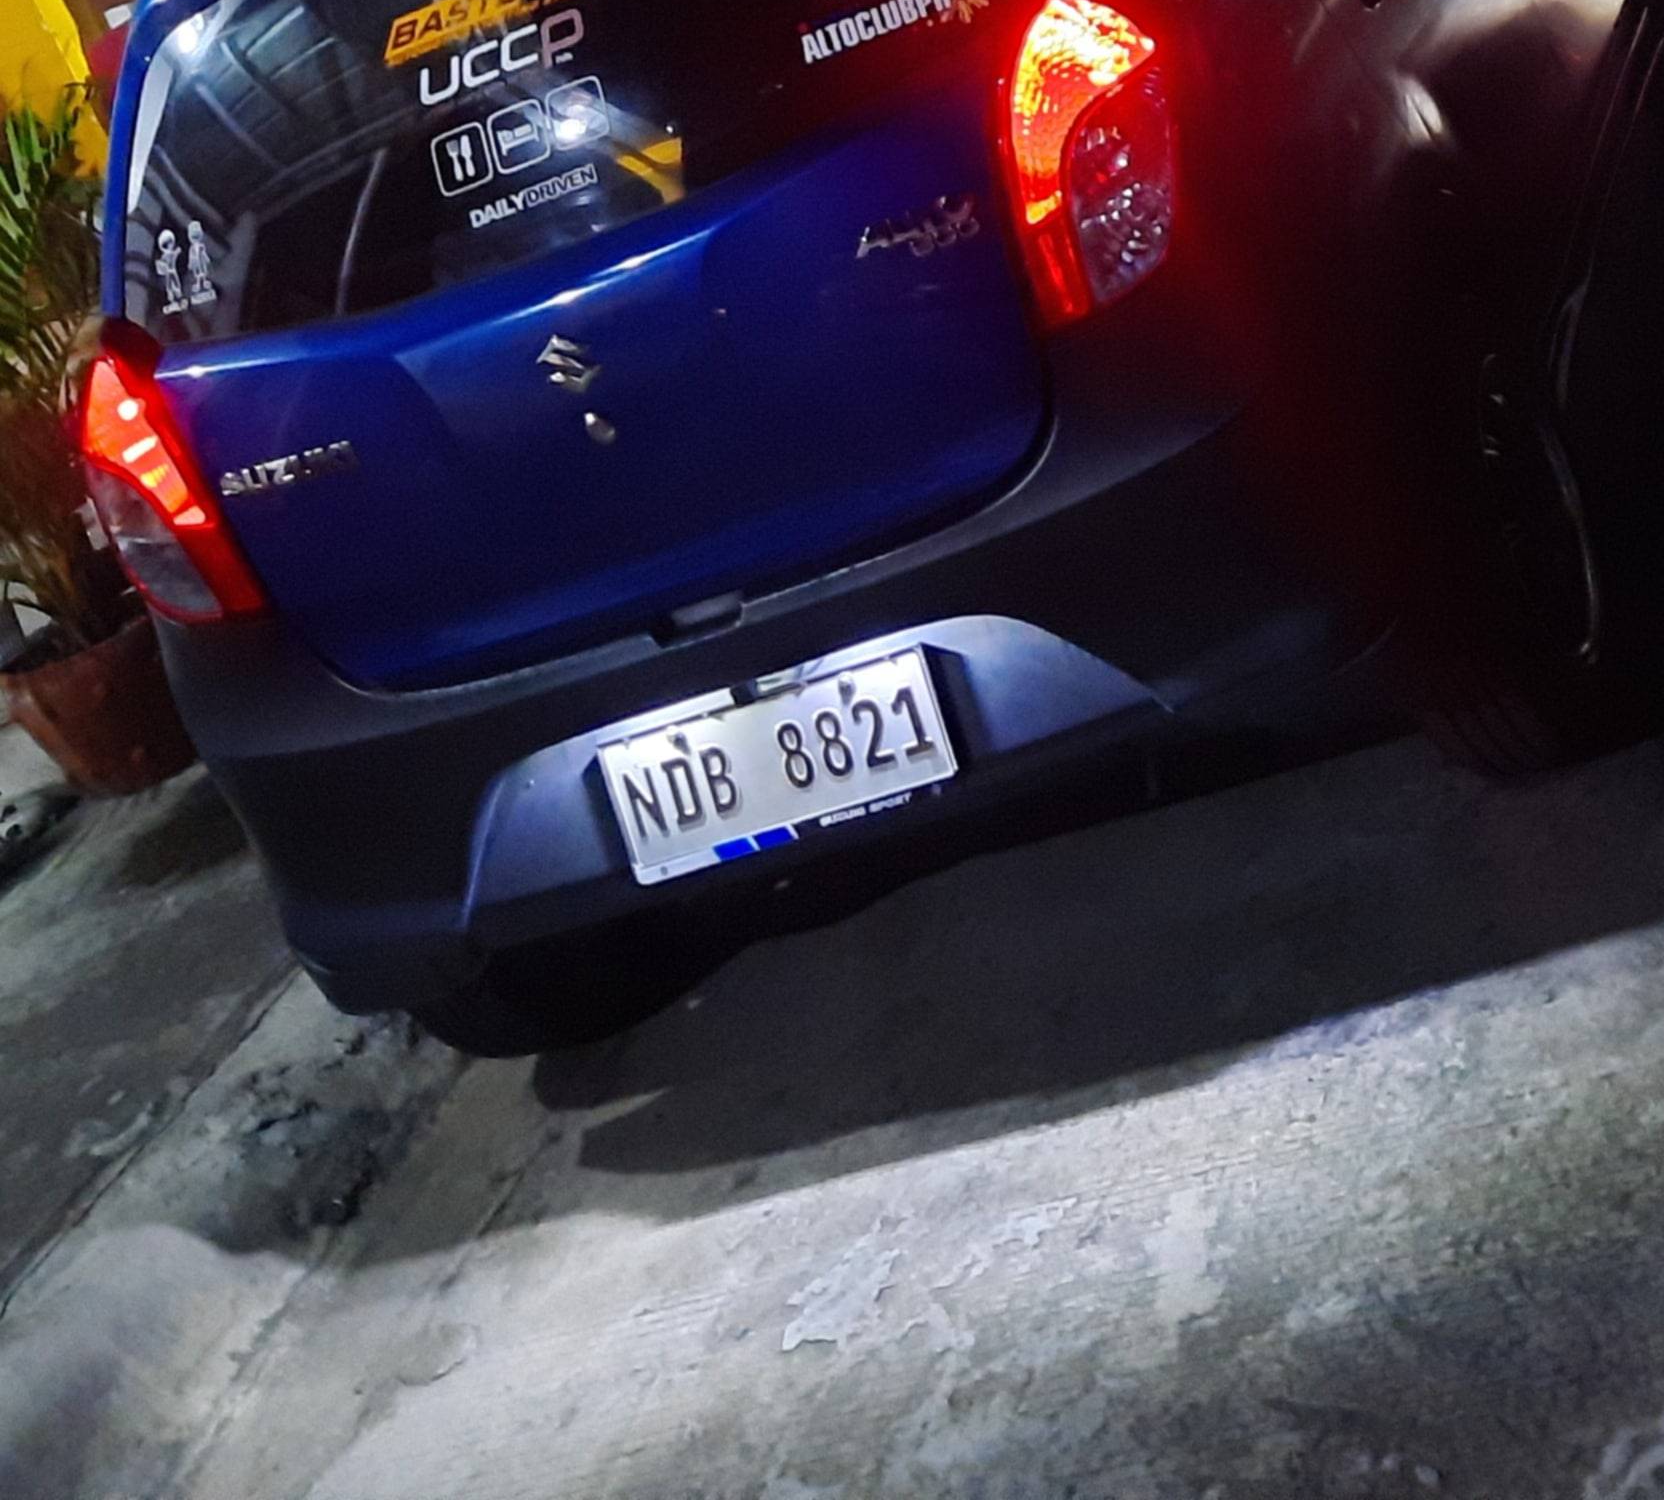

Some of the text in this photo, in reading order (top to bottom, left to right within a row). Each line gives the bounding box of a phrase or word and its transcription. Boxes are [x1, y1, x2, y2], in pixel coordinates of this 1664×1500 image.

[220, 440, 358, 496] SUZ
[622, 686, 935, 839] NDB 8821
